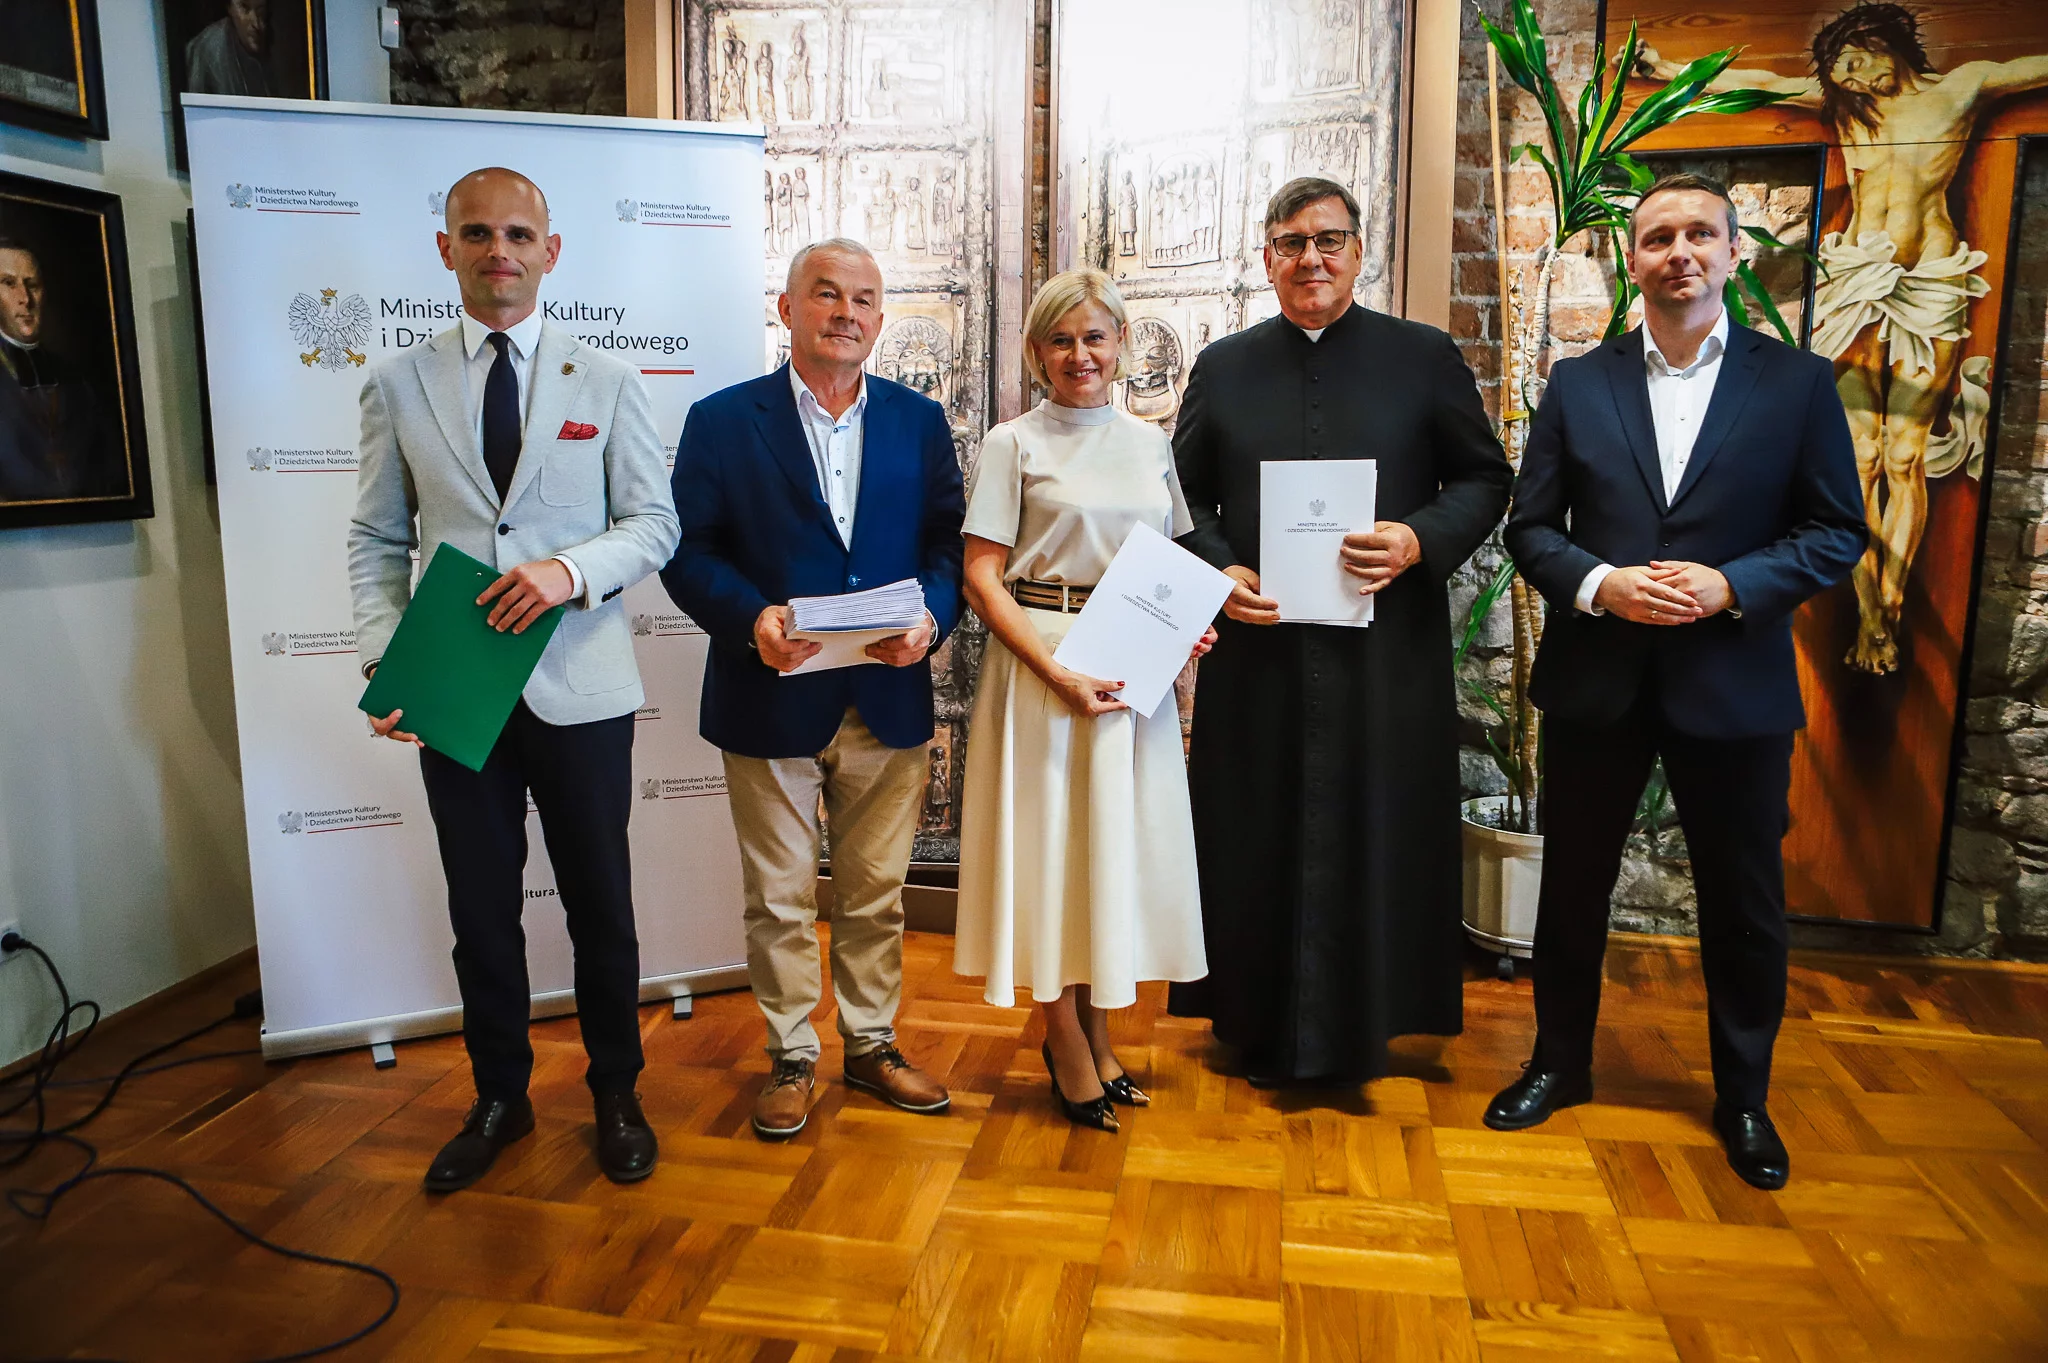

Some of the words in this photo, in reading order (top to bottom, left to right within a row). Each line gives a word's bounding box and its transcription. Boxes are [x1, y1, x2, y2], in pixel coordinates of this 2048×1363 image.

[255, 187, 307, 196] Ministerstwo
[308, 189, 336, 198] Kultury
[260, 196, 308, 205] Dziedzictwa
[309, 198, 358, 208] Narodowego
[640, 202, 684, 210] Ministerstwo
[686, 212, 730, 221] Narodowego
[380, 298, 464, 318] Ministe
[544, 300, 626, 325] Kultury
[382, 328, 386, 348] i
[578, 330, 689, 354] odowego
[274, 449, 324, 457] Ministerstwo
[289, 632, 338, 640] Ministerstwo
[294, 640, 338, 648] Dziedzictwa
[662, 776, 703, 785] Ministerstwo
[666, 784, 704, 793] Dziedzictwa
[305, 809, 352, 818] Ministerstwo
[354, 806, 381, 814] Kultury
[310, 817, 354, 826] Dziedzictwa
[356, 812, 402, 821] Narodowego
[525, 888, 560, 898] ltura.
